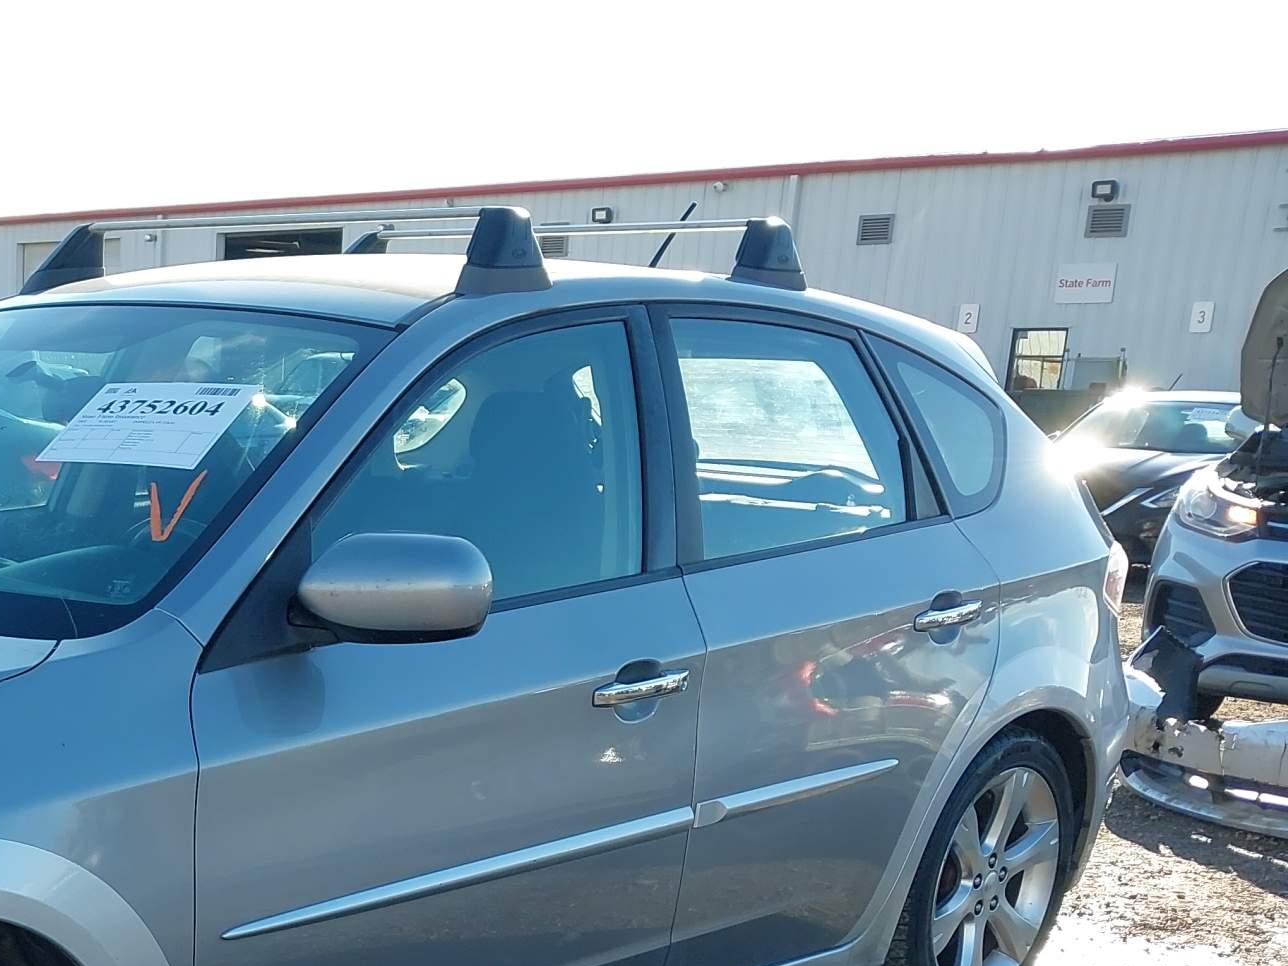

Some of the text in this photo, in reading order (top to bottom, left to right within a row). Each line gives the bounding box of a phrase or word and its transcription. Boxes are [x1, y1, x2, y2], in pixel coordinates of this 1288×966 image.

[1058, 278, 1112, 288] State Farm
[963, 312, 973, 325] 2
[1196, 310, 1206, 324] 3
[96, 399, 226, 417] 43752604
